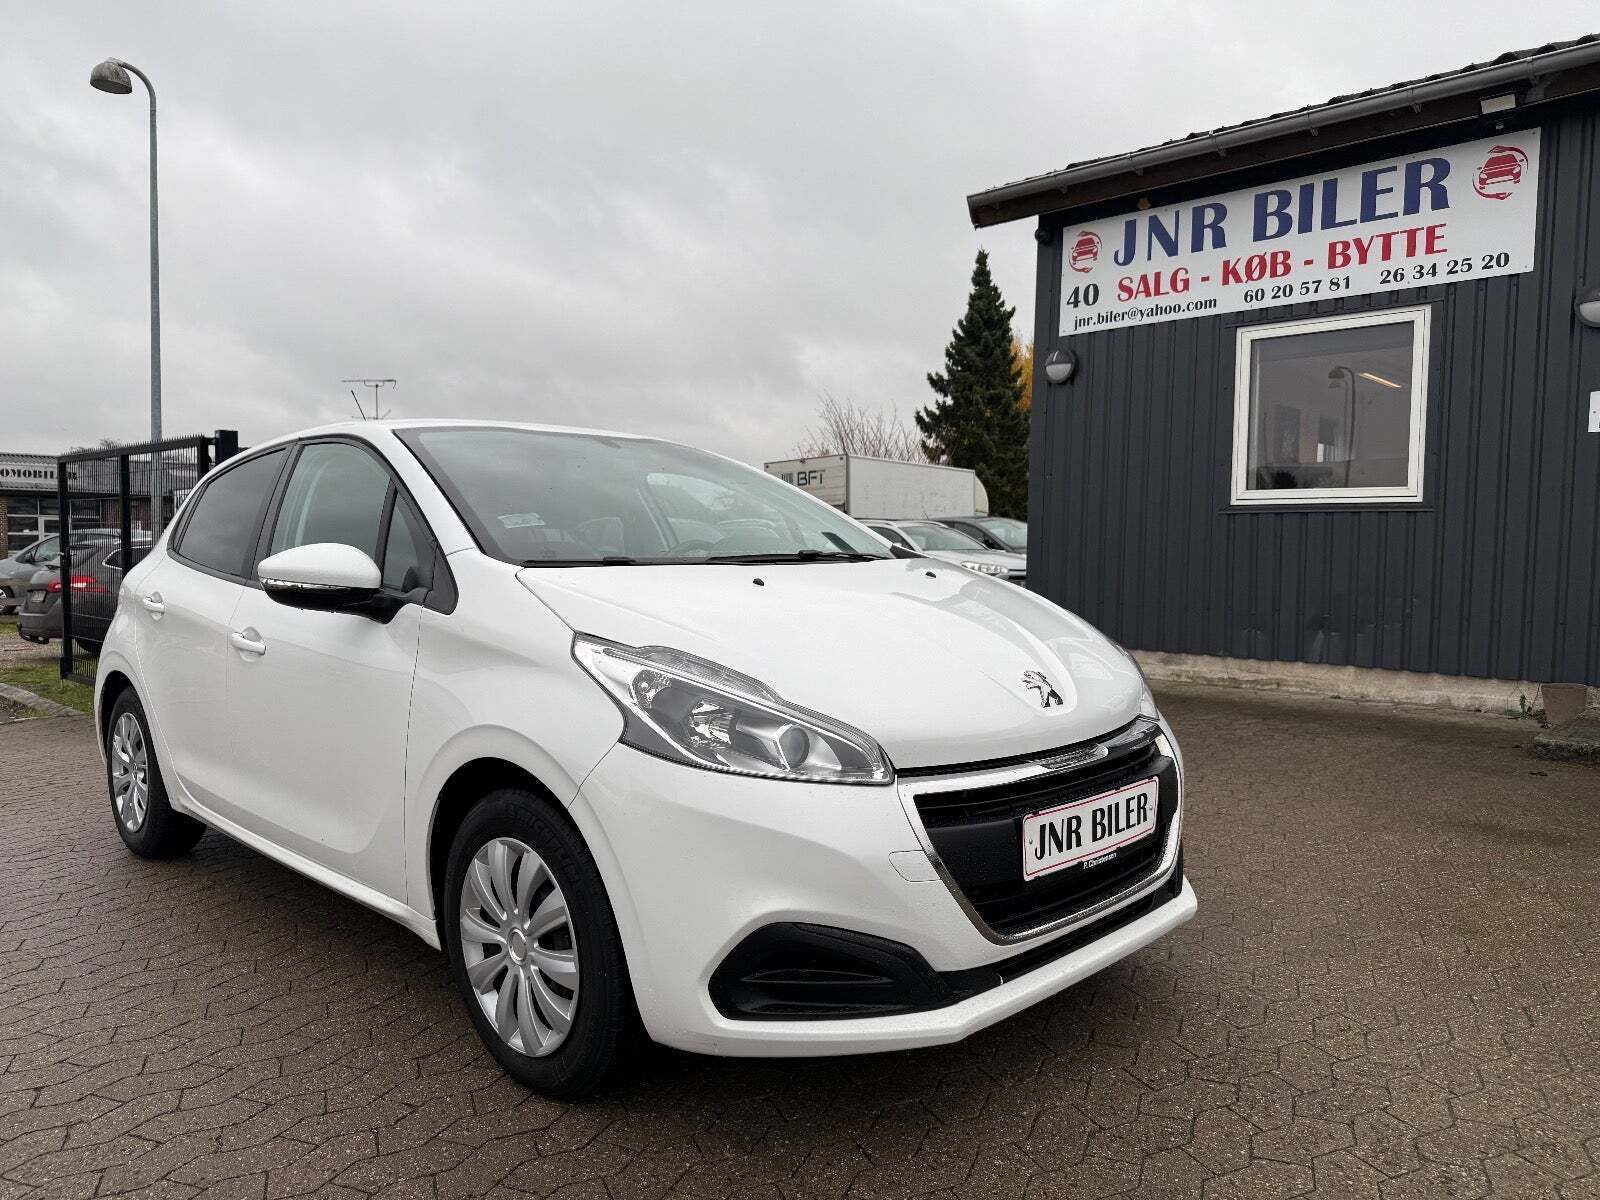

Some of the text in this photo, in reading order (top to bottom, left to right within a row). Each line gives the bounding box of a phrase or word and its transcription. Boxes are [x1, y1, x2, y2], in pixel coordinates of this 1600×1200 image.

[1113, 157, 1451, 267] JNR BILER
[1117, 267, 1190, 302] SALG
[1221, 250, 1292, 286] KØB
[1328, 223, 1448, 270] BYTTE
[1379, 252, 1510, 285] 26 34 25 20
[1066, 283, 1100, 309] 40
[1243, 275, 1351, 303] 60 20 57 81
[1073, 297, 1217, 331] jnr.biler@yahoo.com
[1034, 793, 1148, 860] JNR BILER
